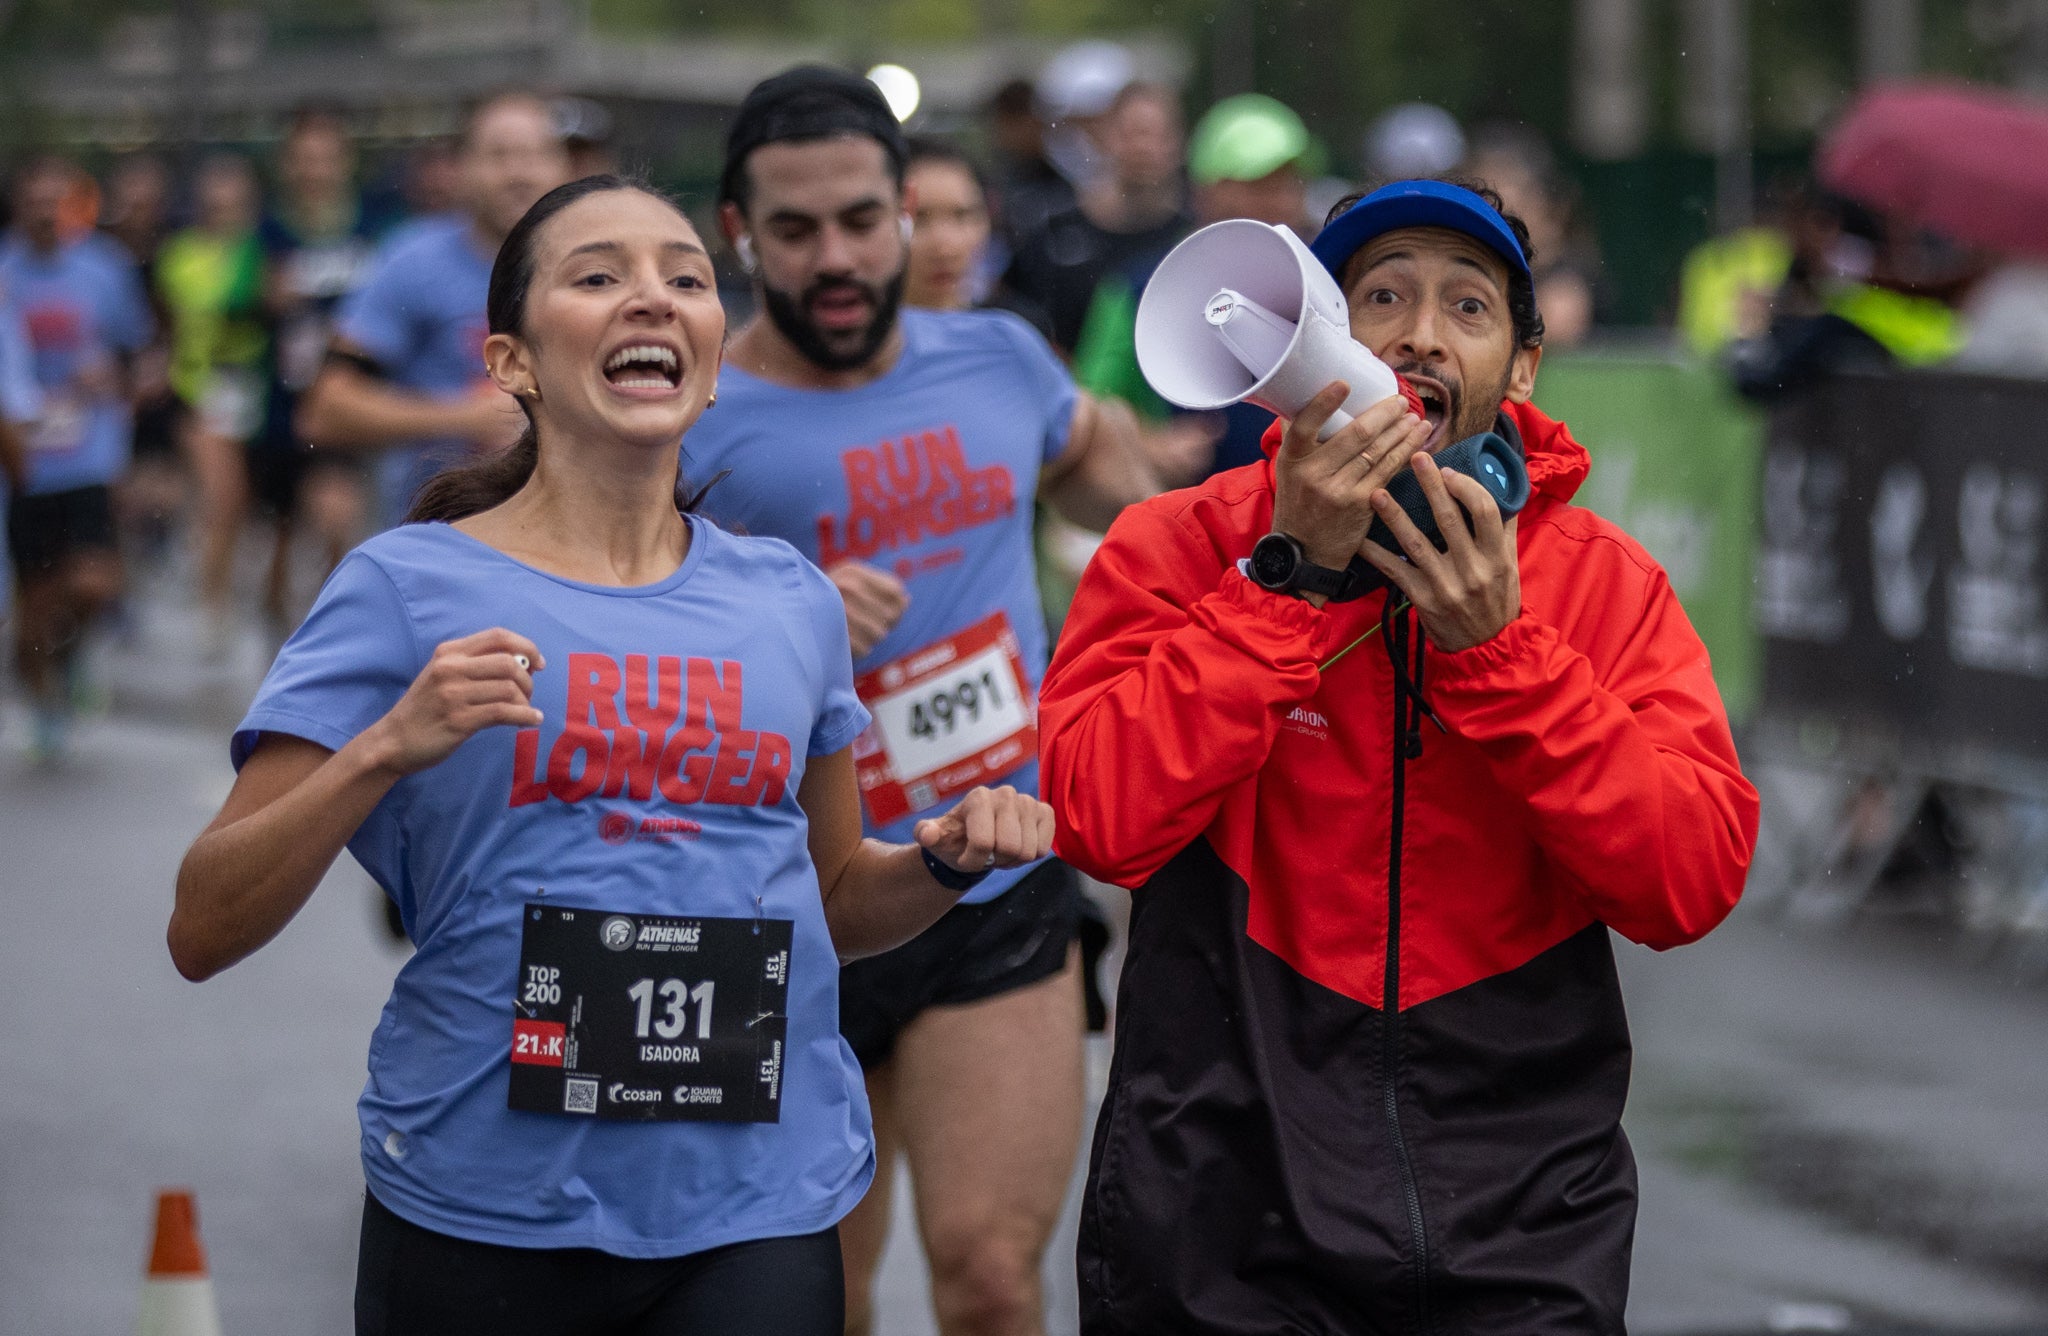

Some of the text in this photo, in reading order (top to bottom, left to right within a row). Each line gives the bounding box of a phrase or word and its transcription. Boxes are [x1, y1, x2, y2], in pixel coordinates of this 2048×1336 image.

[841, 425, 967, 506] RUN
[816, 465, 1015, 572] LONGER
[565, 653, 742, 733] RUN
[907, 670, 1004, 742] 4991
[508, 728, 792, 808] LONGER
[638, 817, 703, 834] ATHENAS
[561, 912, 575, 921] 131
[638, 926, 702, 945] ATHENAS
[635, 943, 699, 953] RUN LONGER
[528, 966, 561, 984] TOP
[766, 955, 780, 980] 131
[524, 982, 561, 1005] 200
[629, 977, 715, 1038] 131
[516, 1033, 563, 1057] 21.1K
[641, 1045, 701, 1063] ISADORA
[760, 1058, 774, 1083] 131
[622, 1089, 662, 1102] cosan
[689, 1095, 723, 1104] SPORTS
[690, 1086, 723, 1097] IGUANA
